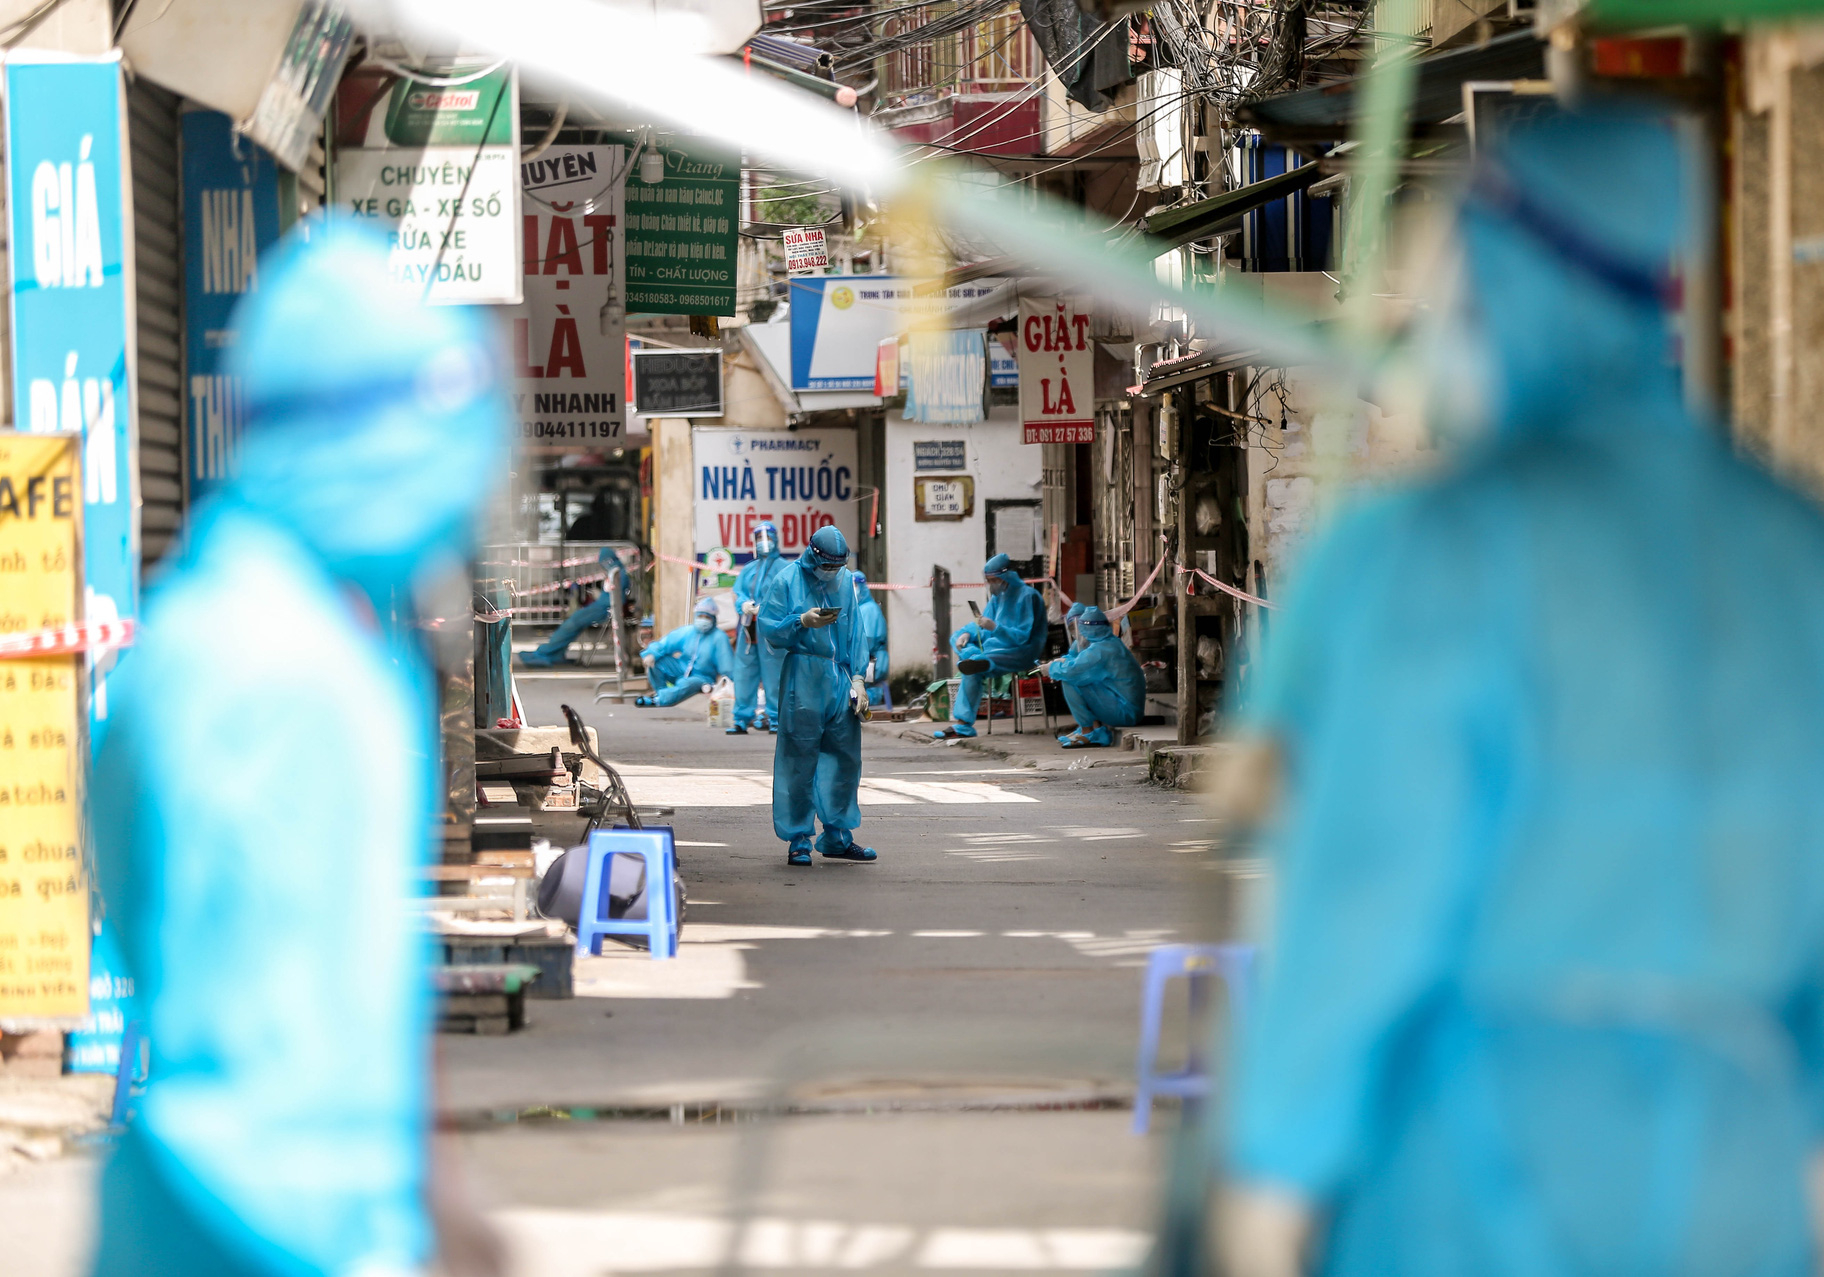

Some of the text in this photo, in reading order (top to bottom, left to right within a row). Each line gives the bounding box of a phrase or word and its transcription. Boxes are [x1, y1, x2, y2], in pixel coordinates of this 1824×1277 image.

[425, 93, 474, 108] Castrol
[381, 161, 471, 186] CHUYÊN
[521, 151, 598, 187] HUYÊN
[31, 133, 104, 289] GIÁ
[352, 198, 379, 219] XE
[386, 198, 417, 218] GA
[437, 199, 465, 217] XE
[472, 190, 502, 218] SỐ
[440, 230, 467, 250] XE
[523, 201, 617, 290] IẶT
[656, 265, 687, 280] CHẤT
[513, 304, 588, 379] LÀ
[1024, 303, 1090, 363] GIẶT
[534, 393, 617, 414] NHANH
[1040, 366, 1077, 415] LÀ
[751, 439, 821, 451] PHARMACY
[701, 452, 852, 502] NHÀ THUỐC
[0, 474, 74, 520] AFE
[718, 506, 773, 553] VIỆ
[0, 783, 66, 805] atcha
